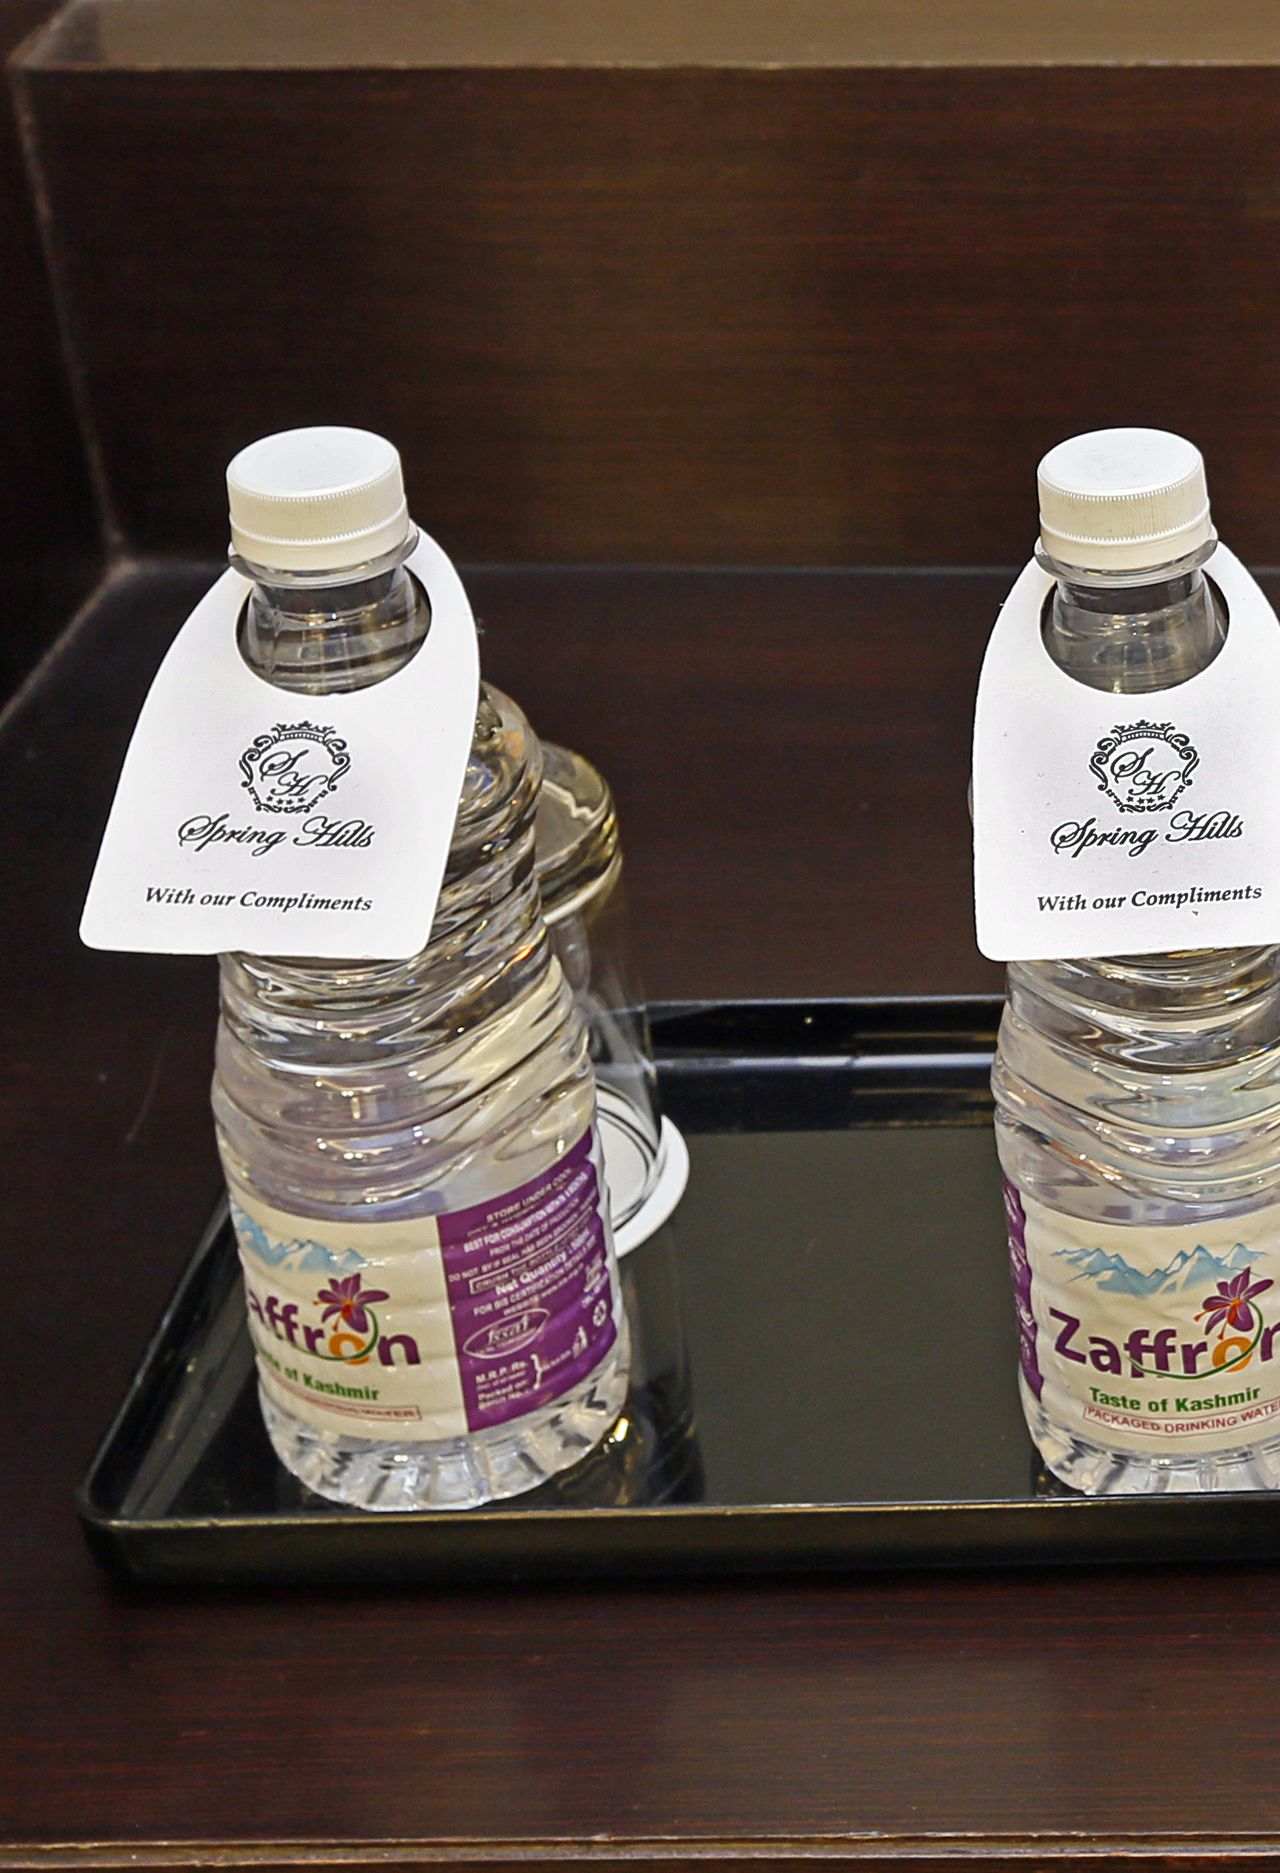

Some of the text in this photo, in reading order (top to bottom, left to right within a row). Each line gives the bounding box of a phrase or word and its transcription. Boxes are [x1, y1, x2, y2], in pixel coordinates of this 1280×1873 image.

[178, 813, 375, 857] Spring Hills
[1050, 811, 1244, 858] Spring Hills
[146, 887, 373, 913] With our Compliments
[1037, 885, 1262, 911] With our Compliments
[486, 1202, 521, 1223] STORE
[522, 1183, 552, 1206] UNDER
[463, 1237, 484, 1253] BEST
[484, 1231, 501, 1246] FOR
[500, 1208, 547, 1240] CONSUMPTION
[489, 1243, 511, 1256] FROM
[511, 1236, 524, 1247] THE
[524, 1229, 540, 1243] DATE
[448, 1272, 461, 1283] DO
[461, 1267, 479, 1279] NOT
[501, 1253, 520, 1265] SEAL
[495, 1279, 519, 1296] Net
[520, 1251, 566, 1284] Quantity
[473, 1302, 494, 1316] FOR
[510, 1267, 565, 1302] CERTIFICATION
[249, 1289, 421, 1367] affron
[285, 1367, 299, 1381] of
[303, 1373, 380, 1400] Kashmir
[478, 1384, 513, 1400] Packed
[1089, 1387, 1261, 1412] Taste of Kashmir
[1087, 1406, 1160, 1431] PACKAGED
[1164, 1416, 1237, 1433] DRINKING
